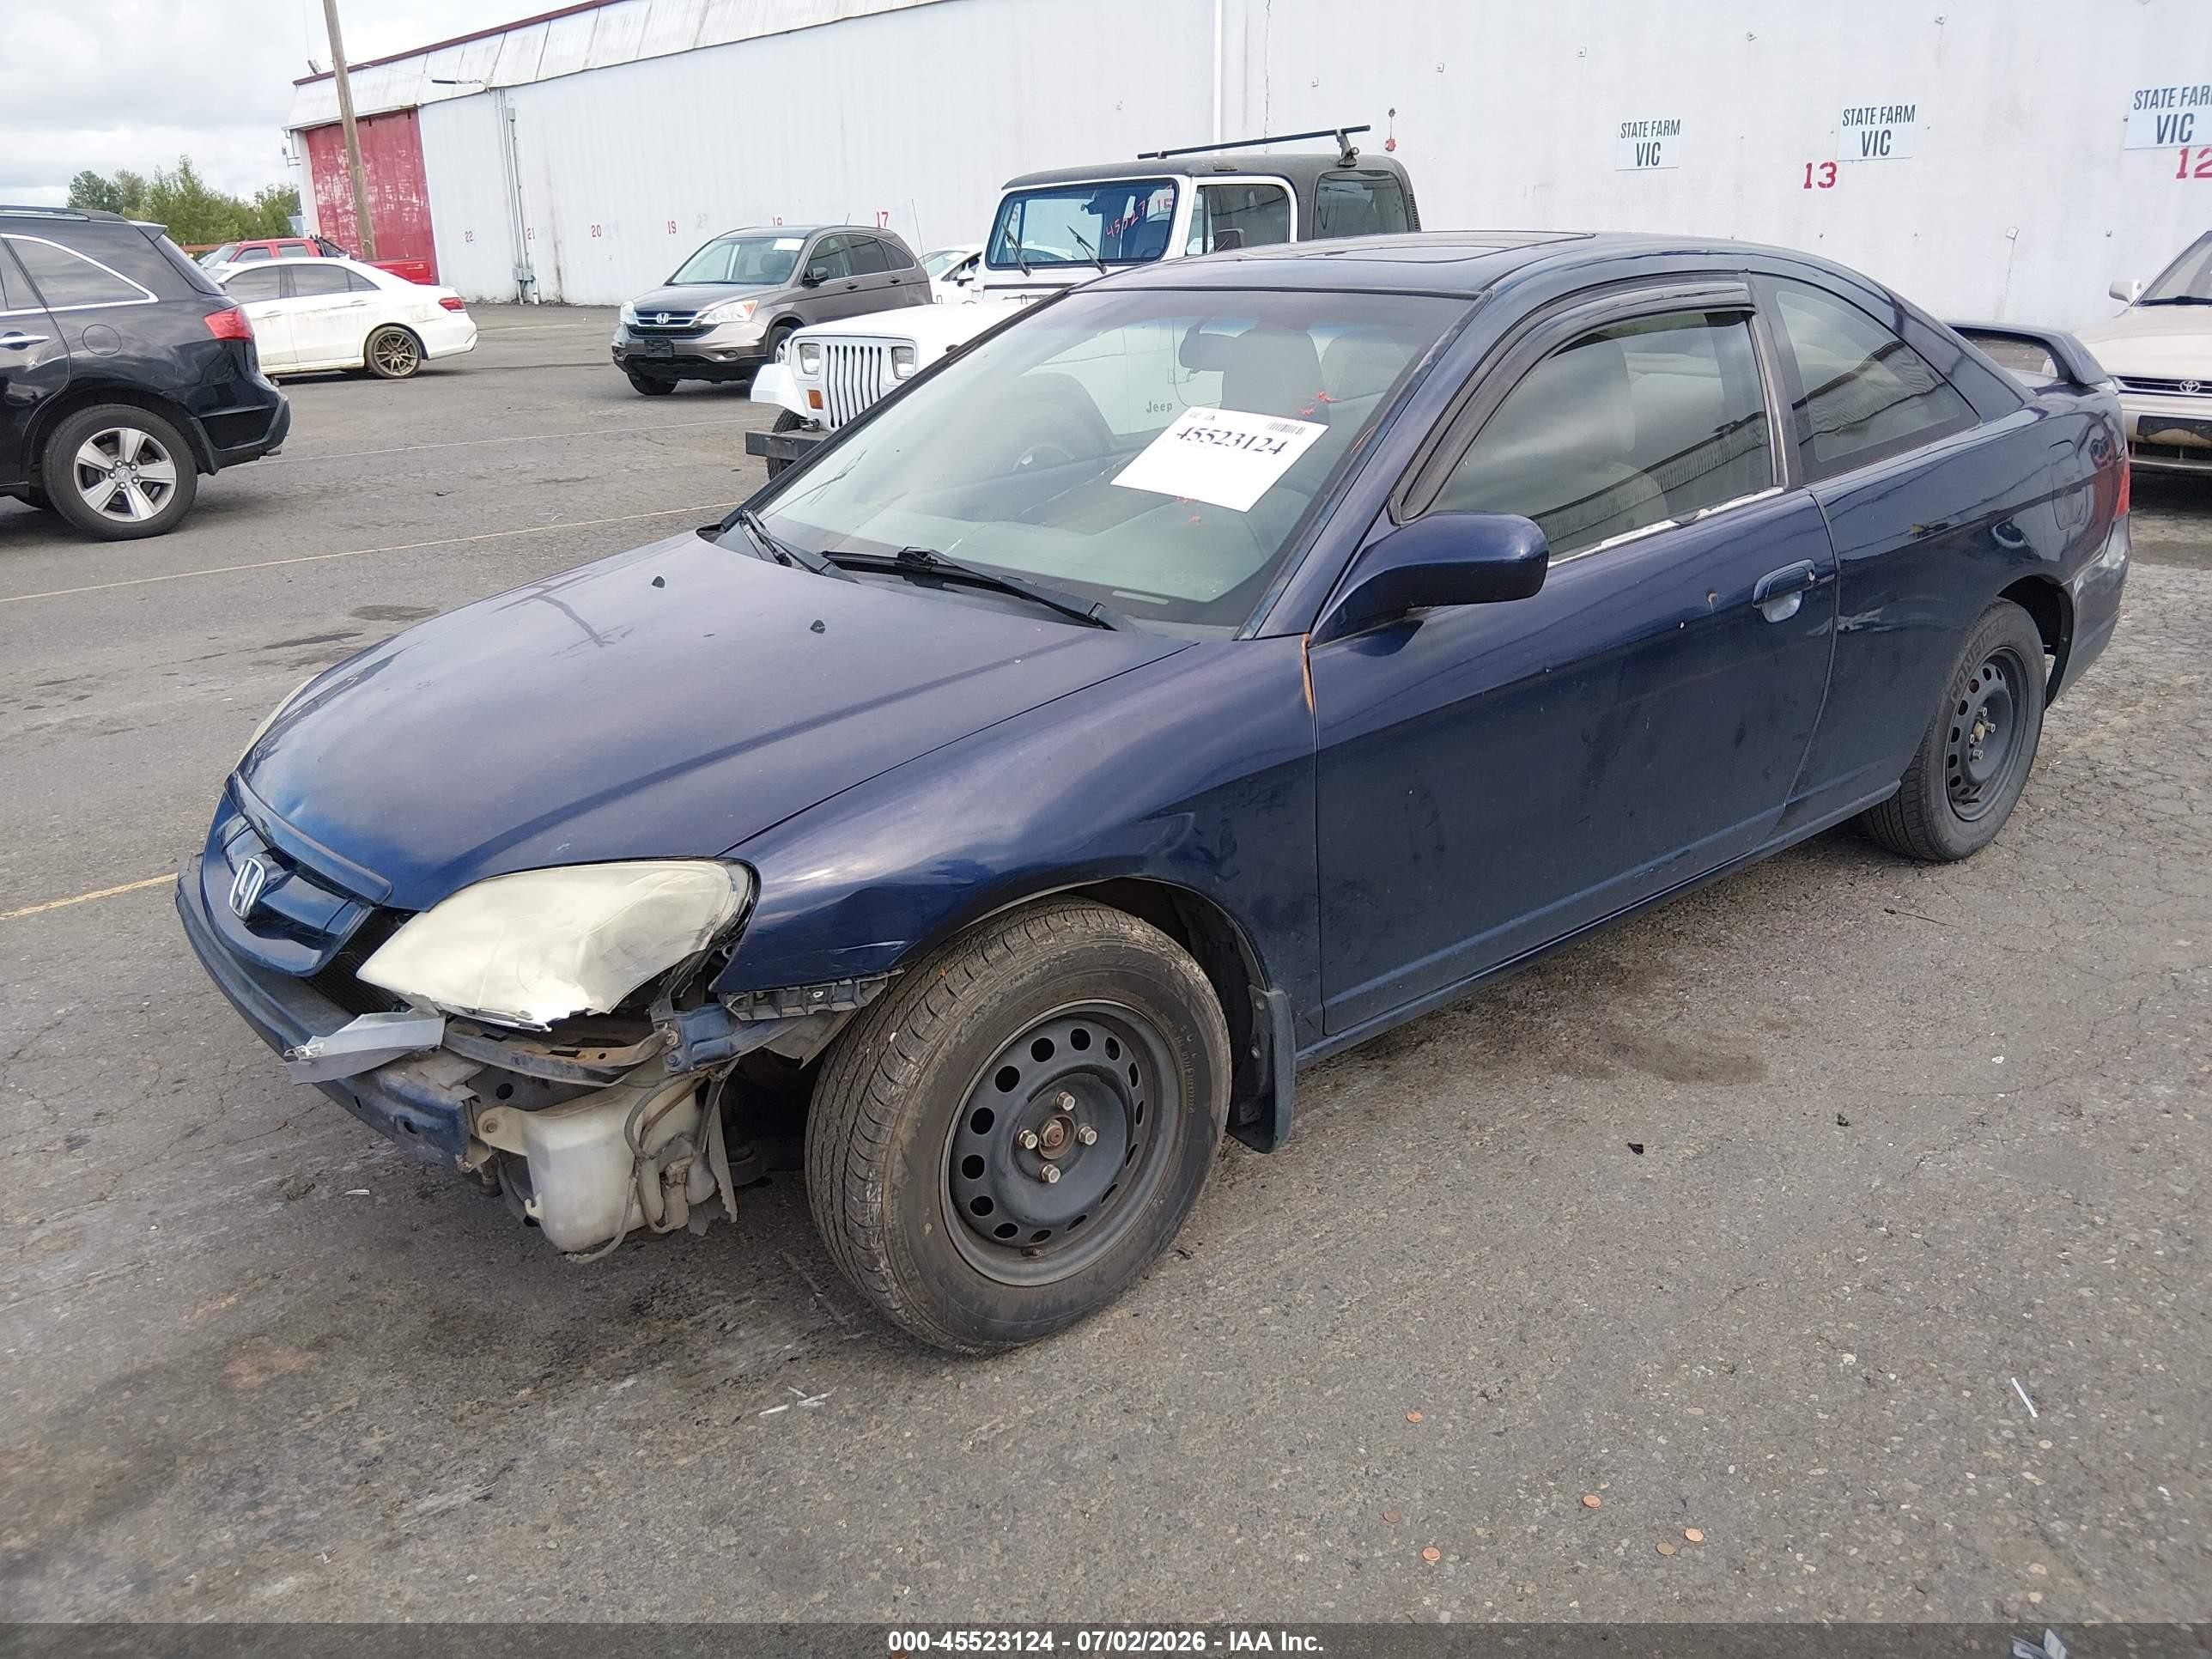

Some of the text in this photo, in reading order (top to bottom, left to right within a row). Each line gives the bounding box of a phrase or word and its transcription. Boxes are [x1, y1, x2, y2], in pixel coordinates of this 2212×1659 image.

[2133, 85, 2212, 111] STATE FAR
[1842, 104, 1916, 127] STATE FARM
[1620, 118, 1681, 139] STATE FARM
[2156, 112, 2195, 145] VIC
[1636, 141, 1662, 167] VIC
[1861, 129, 1892, 157] VIC
[1803, 161, 1838, 189] 13
[2176, 147, 2212, 179] 12
[591, 224, 602, 238] 20
[877, 211, 890, 228] 17
[465, 230, 474, 242] 22
[527, 228, 536, 240] 21
[1146, 400, 1173, 414] Jeep
[1176, 426, 1288, 455] 45523124
